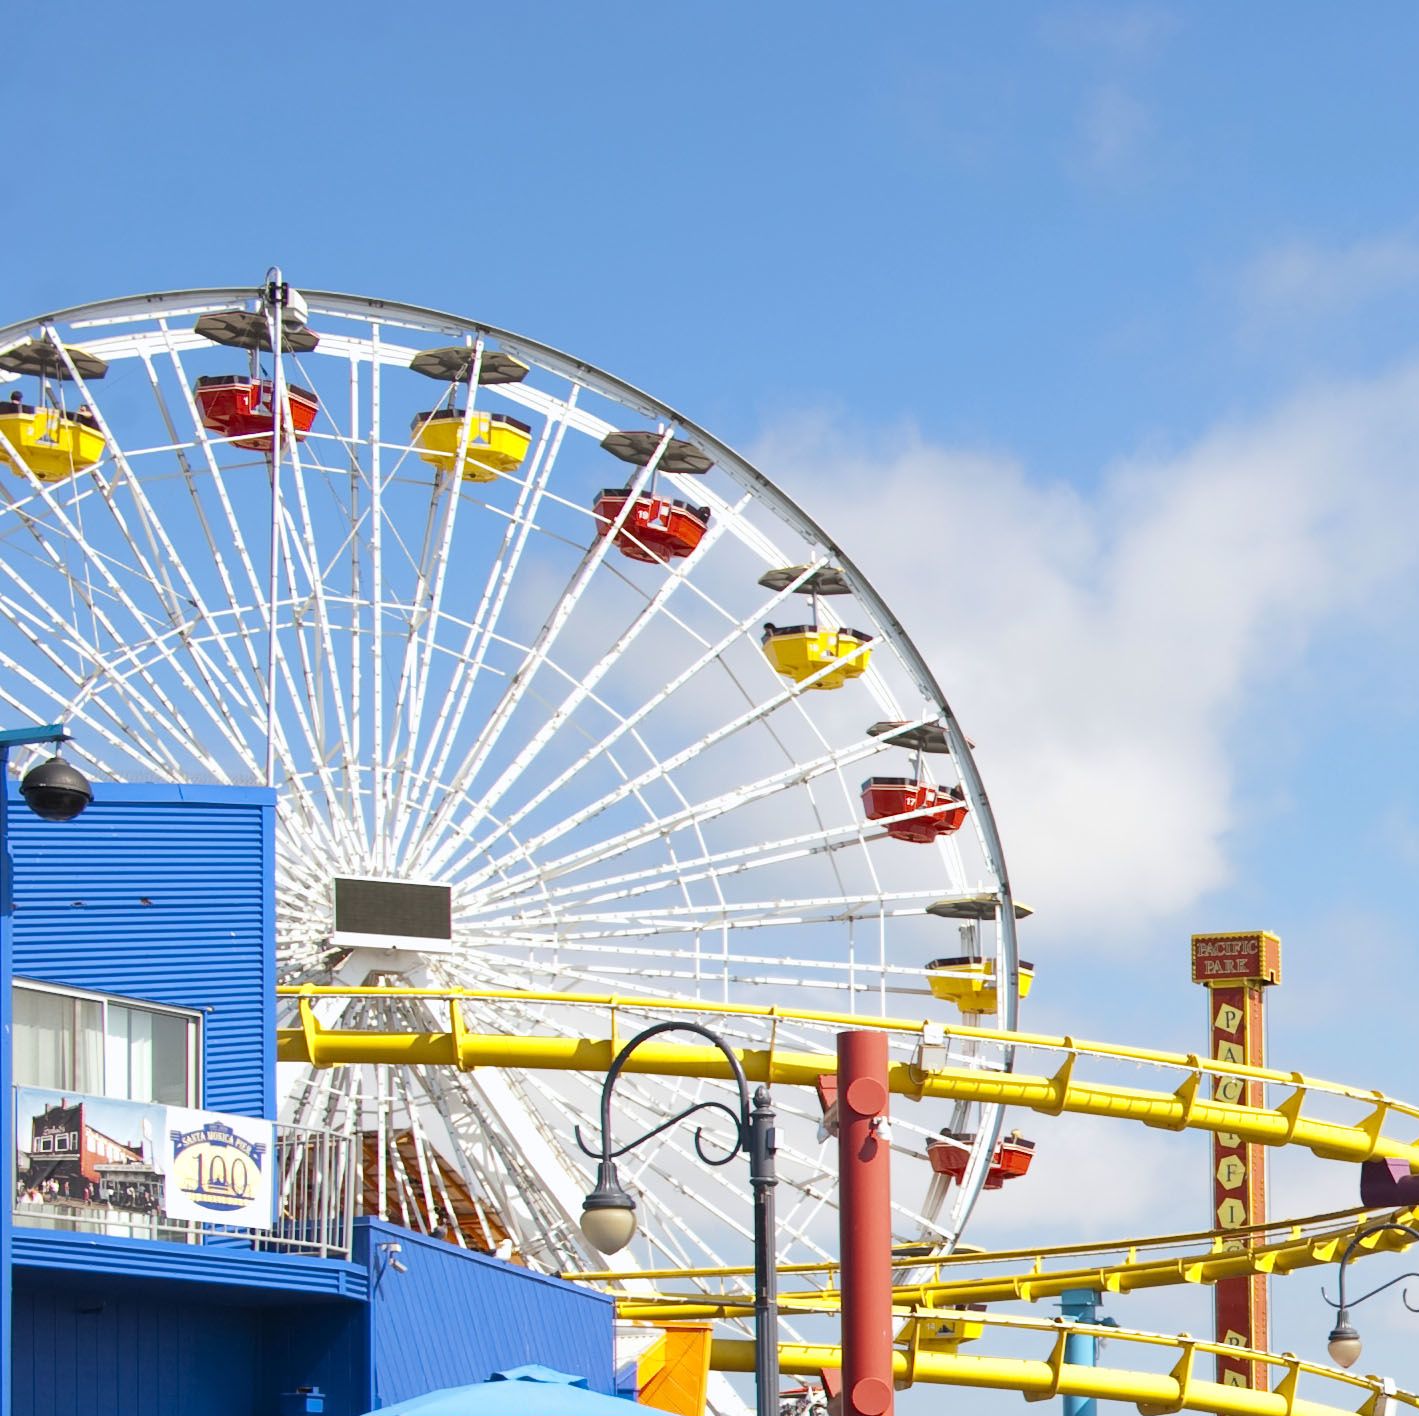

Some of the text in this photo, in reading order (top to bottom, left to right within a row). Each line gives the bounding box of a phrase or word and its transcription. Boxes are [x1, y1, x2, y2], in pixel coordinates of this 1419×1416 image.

[1197, 940, 1258, 957] PACIFIC
[1204, 958, 1249, 975] PARK
[182, 1130, 207, 1145] SANTA
[192, 1152, 248, 1198] 100
